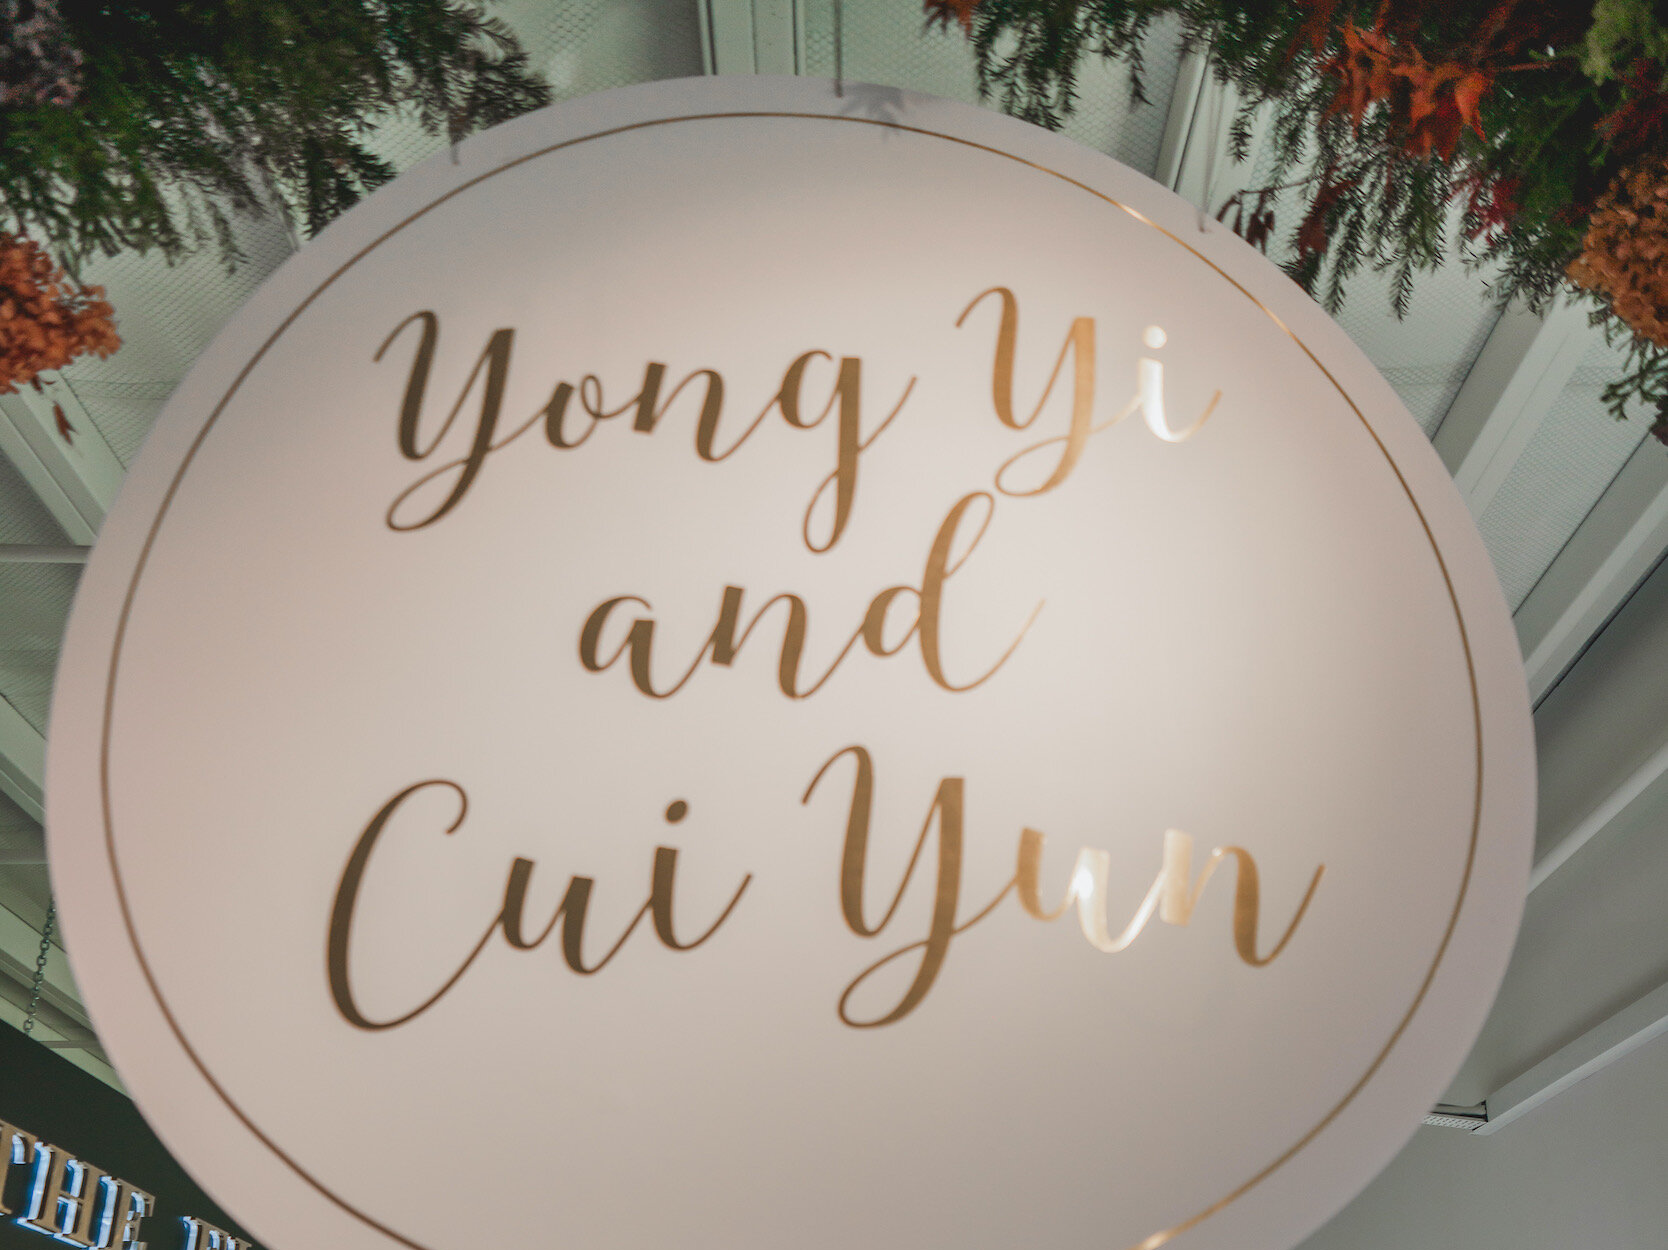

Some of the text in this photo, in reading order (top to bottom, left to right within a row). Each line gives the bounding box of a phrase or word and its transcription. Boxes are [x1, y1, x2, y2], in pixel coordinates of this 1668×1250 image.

[372, 285, 1224, 555] Yong Yi
[578, 490, 1047, 701] and
[325, 744, 1326, 1033] Cui Yun
